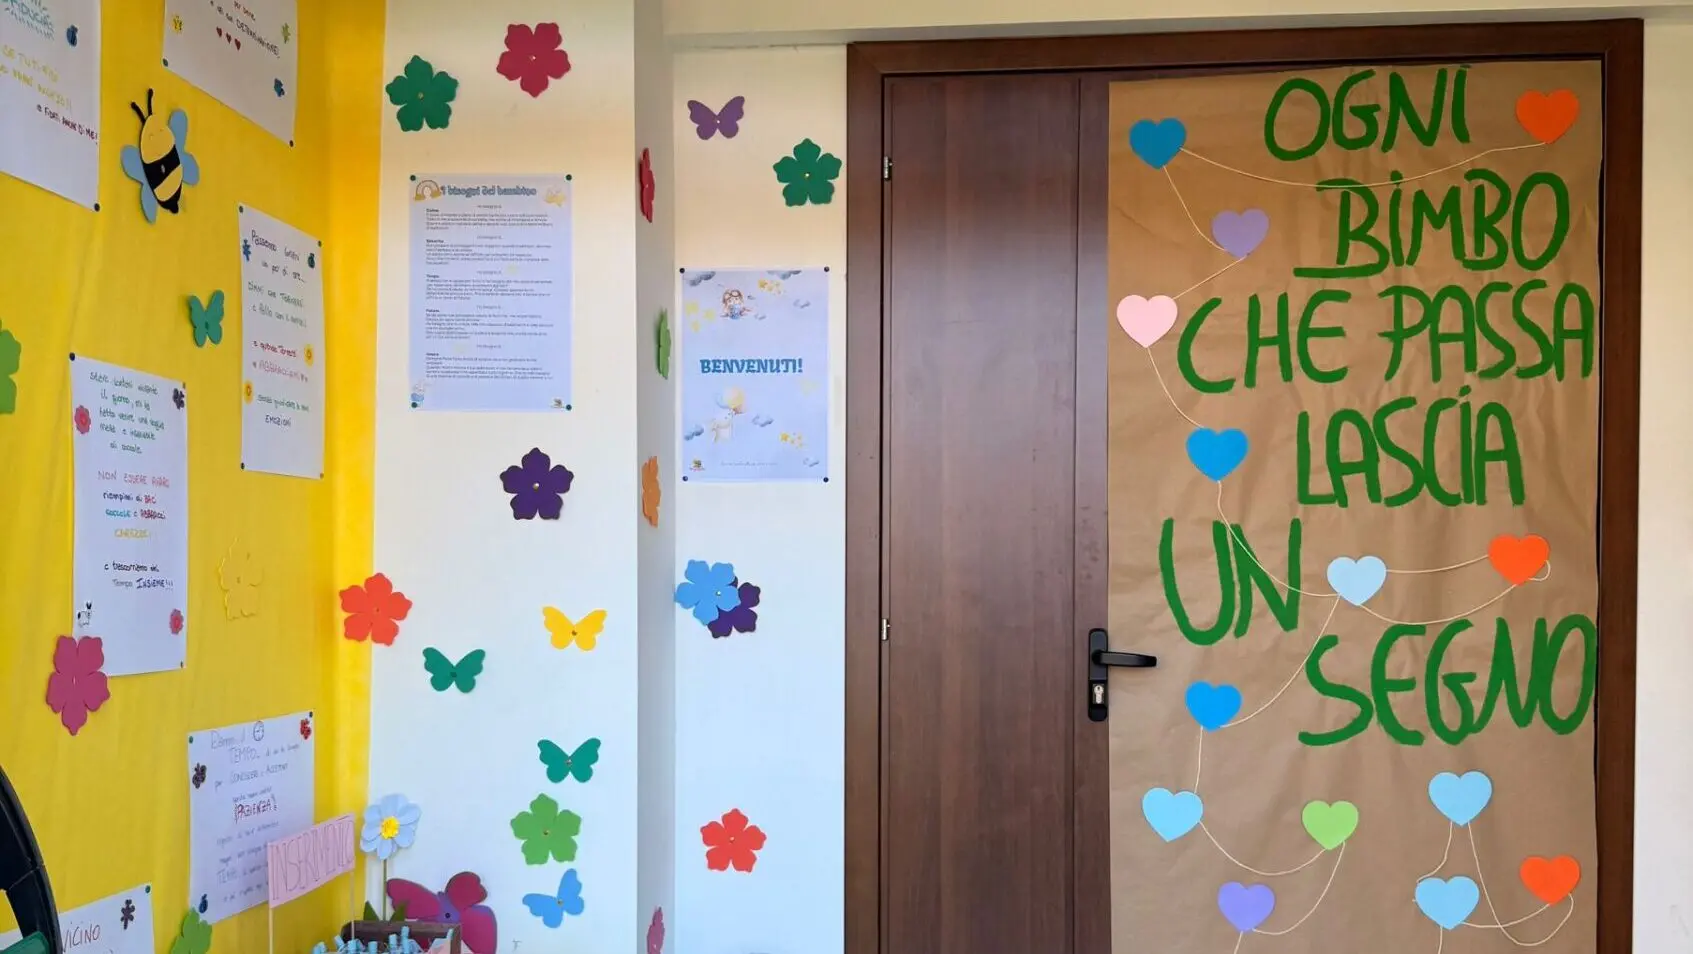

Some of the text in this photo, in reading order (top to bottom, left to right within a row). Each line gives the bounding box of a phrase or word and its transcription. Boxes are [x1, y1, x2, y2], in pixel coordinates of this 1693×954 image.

[1265, 65, 1471, 161] OGNI
[447, 185, 480, 198] bisogni
[497, 185, 537, 196] bambino
[1293, 169, 1570, 279] BIMBO
[700, 358, 803, 374] BENVENUTI!
[1177, 279, 1595, 394] CHE PASSA
[1296, 385, 1526, 508] LASCIA
[1158, 517, 1302, 647] UN
[1297, 613, 1598, 747] SEGNO
[270, 815, 354, 900] INSERIMENTO
